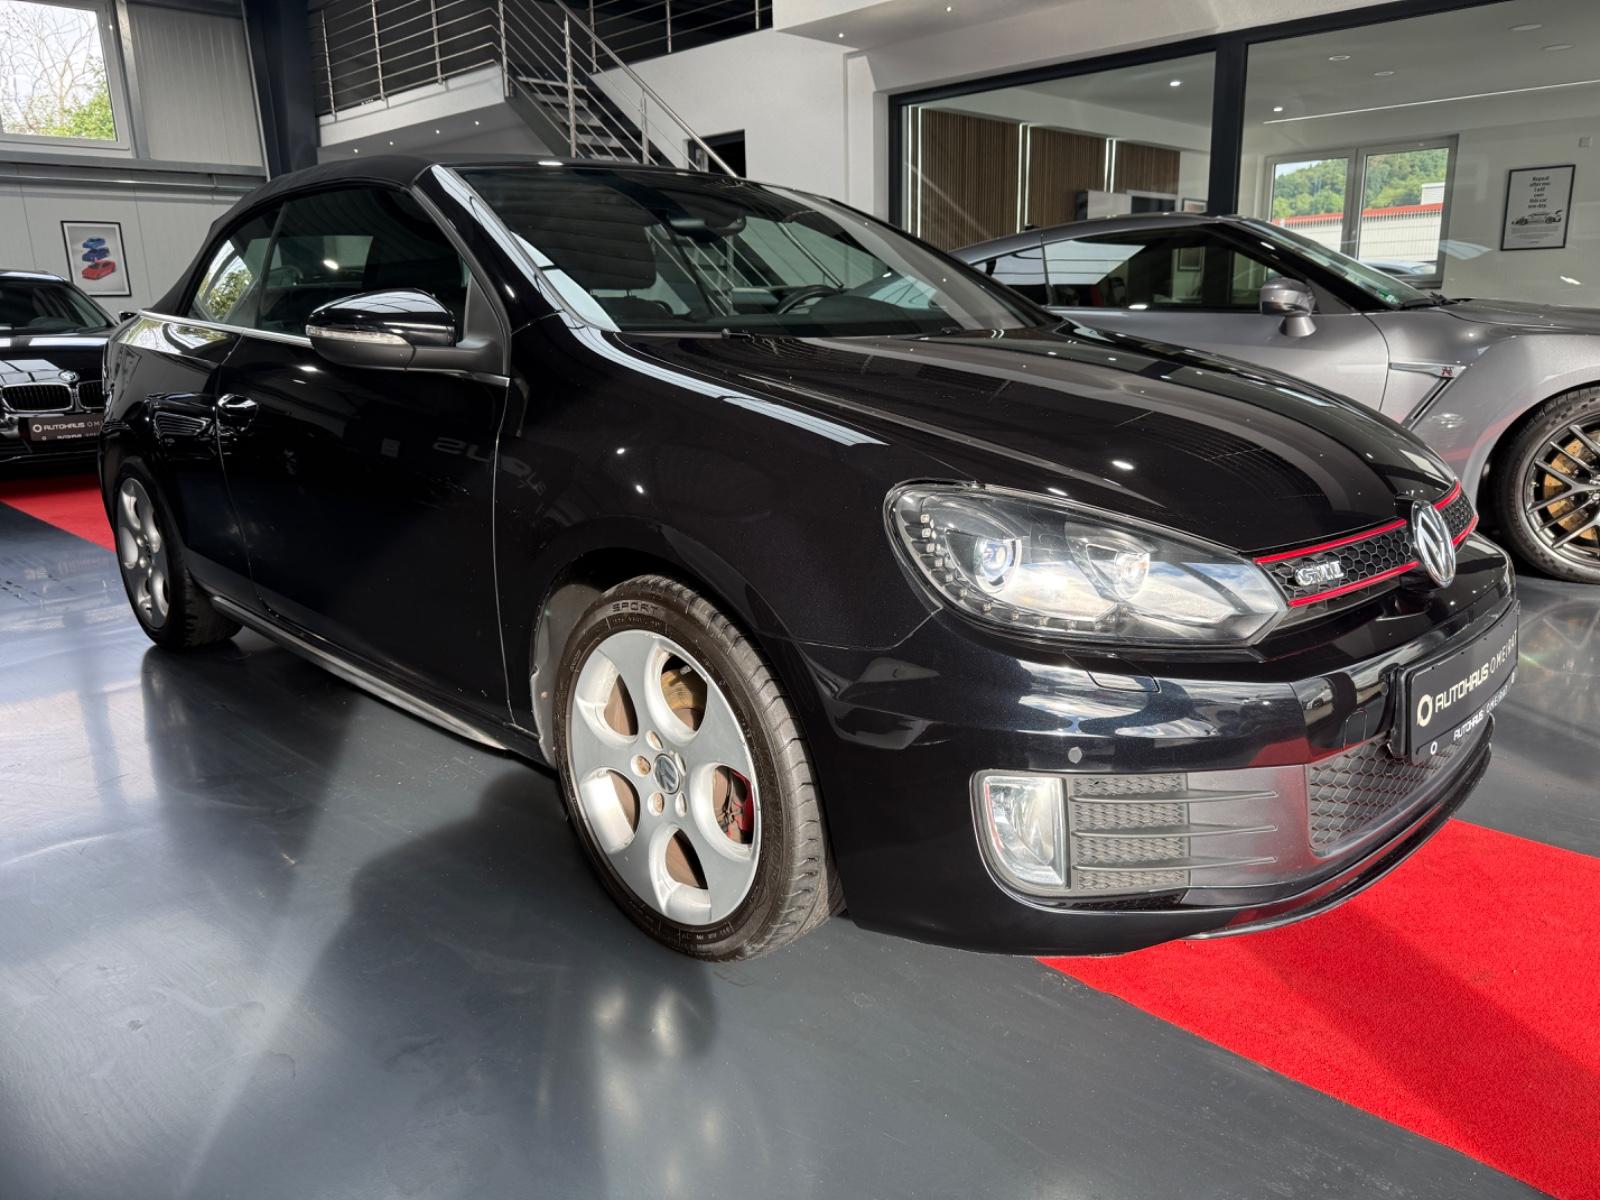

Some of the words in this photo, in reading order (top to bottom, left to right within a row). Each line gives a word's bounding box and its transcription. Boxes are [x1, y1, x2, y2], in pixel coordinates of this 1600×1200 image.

[43, 422, 85, 431] AUTOHAUS
[1295, 561, 1344, 586] GTI
[612, 601, 658, 613] SPORT
[1435, 662, 1489, 713] AUTOHAUS
[1453, 709, 1484, 741] AUTOHAUS
